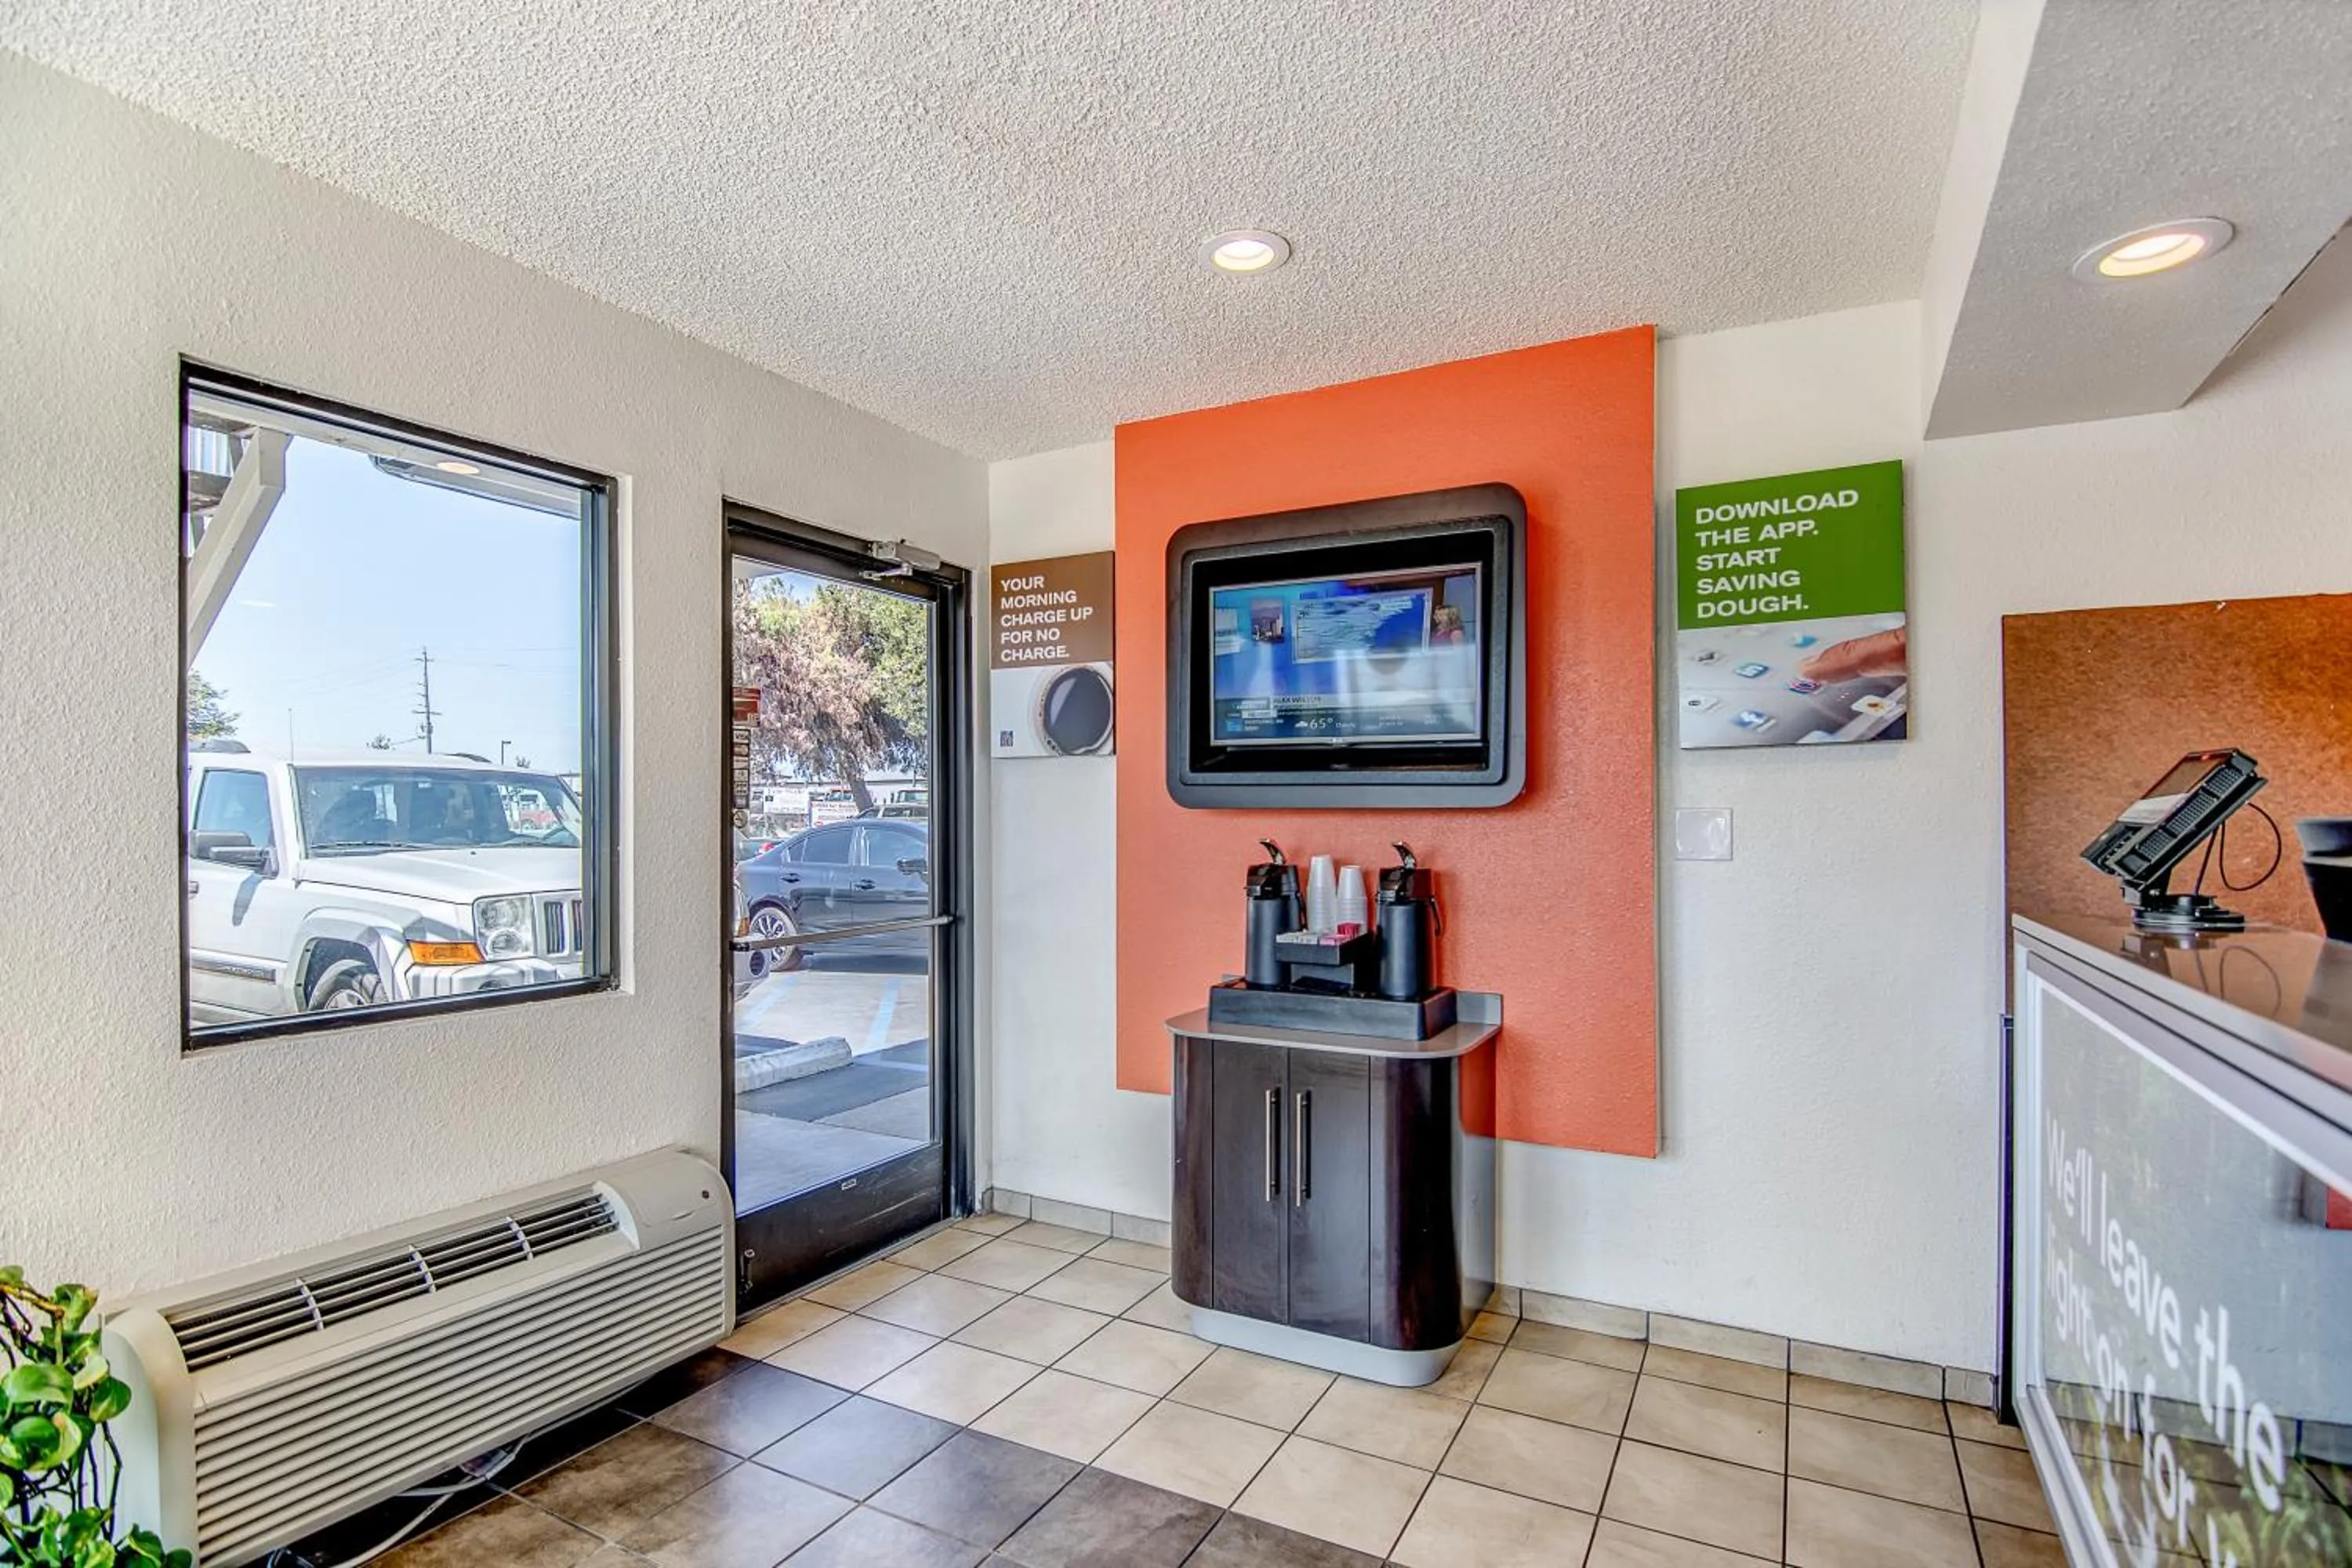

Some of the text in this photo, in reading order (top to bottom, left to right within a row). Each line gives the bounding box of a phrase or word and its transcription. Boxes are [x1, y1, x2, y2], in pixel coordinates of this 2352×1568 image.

[1695, 489, 1859, 524] DOWNLOAD
[1695, 520, 1819, 547] THE APP.
[1696, 547, 1781, 572] START
[1000, 575, 1044, 592] YOUR
[1697, 570, 1801, 595] SAVING
[1000, 590, 1077, 610] MORNING
[1697, 594, 1809, 619] DOUGH.
[1000, 607, 1094, 627] CHARGE UP
[1000, 628, 1061, 645] FOR NO
[1000, 645, 1070, 662] CHARGE.
[2045, 1107, 2092, 1247] We'll
[2100, 1171, 2182, 1369] leave
[2194, 1305, 2285, 1512] the
[2045, 1211, 2197, 1548] light on for
